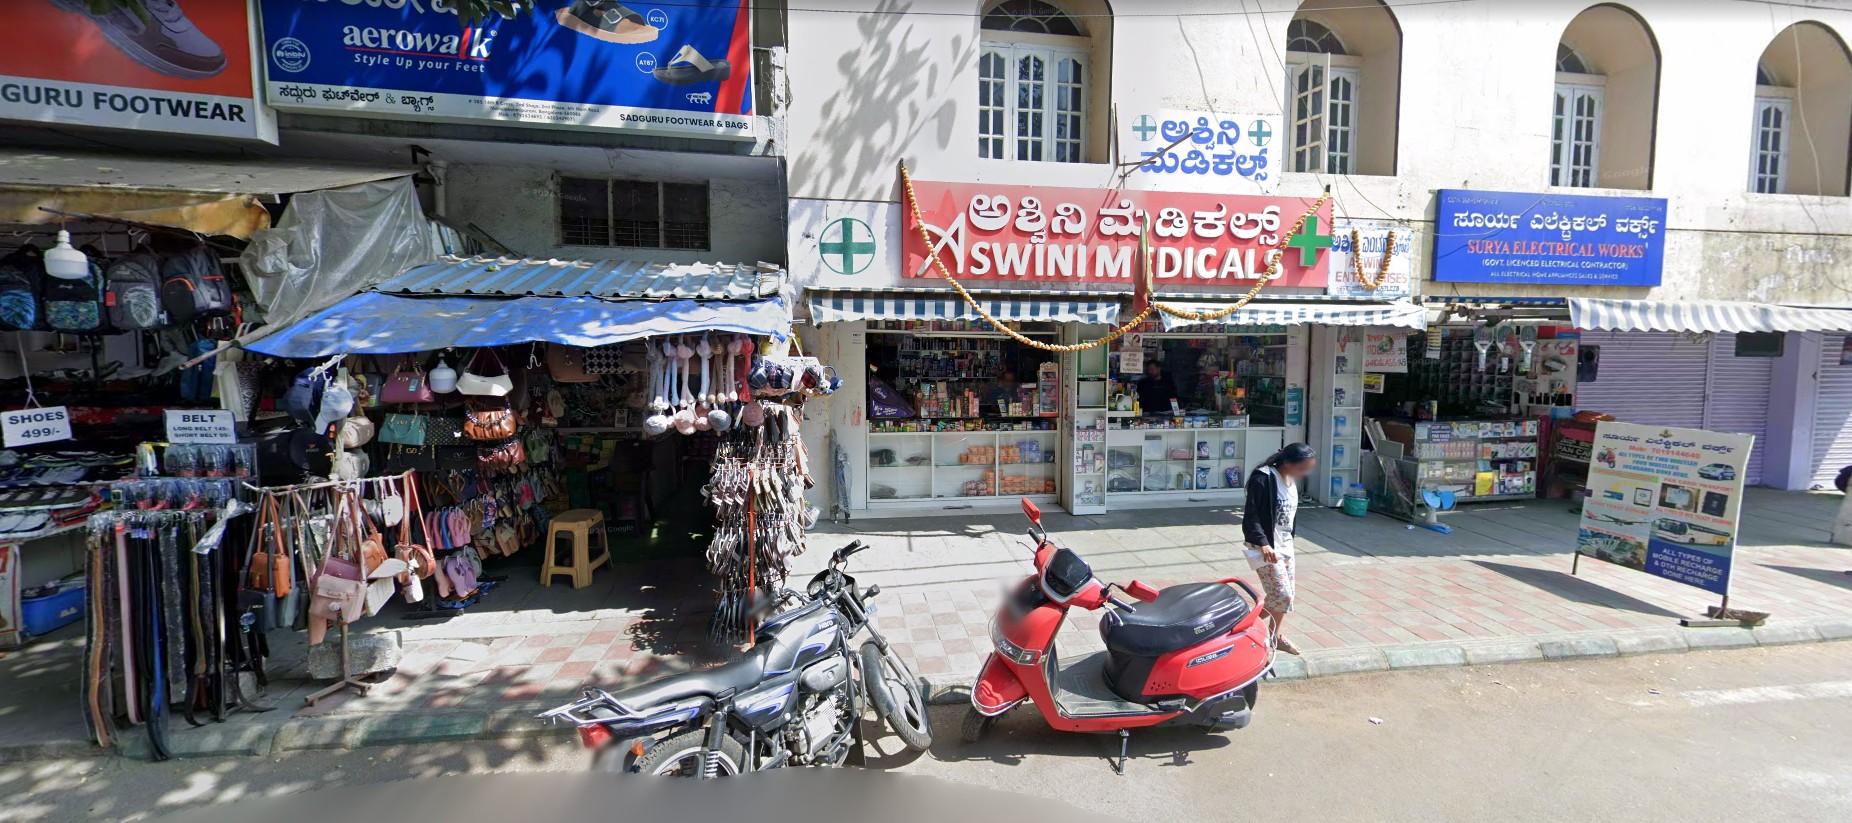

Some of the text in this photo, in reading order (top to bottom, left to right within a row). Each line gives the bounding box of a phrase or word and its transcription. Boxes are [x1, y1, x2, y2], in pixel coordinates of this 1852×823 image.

[343, 25, 492, 59] aerowalk
[354, 53, 485, 72] Style Up your Feet
[1, 83, 246, 122] GURU FOOTWEAR
[385, 92, 396, 104] &
[620, 113, 748, 130] SADGURU FOOTWEAR & BAGS
[1161, 116, 1240, 150] ಅಶ್ವಿನಿ
[969, 194, 1281, 245] ಅಶ್ವಿನಿ ಮೆಡಿಕಲ್ಸ್
[1467, 239, 1644, 258] SURYA ELECTRICAL WORKS
[1095, 244, 1284, 280] MDICALS
[1506, 259, 1539, 267] LICENCED
[1541, 260, 1579, 268] ELECTRICAL
[8, 411, 65, 425] SHOES
[182, 414, 216, 423] BELT
[20, 428, 60, 439] 499/-
[1652, 552, 1723, 576] MOBILE RECHARGE
[1662, 548, 1676, 557] ALL
[1678, 551, 1701, 562] TYPES
[1661, 561, 1676, 570] DTH
[1676, 565, 1719, 582] RECHARGE
[1662, 569, 1683, 580] DONE
